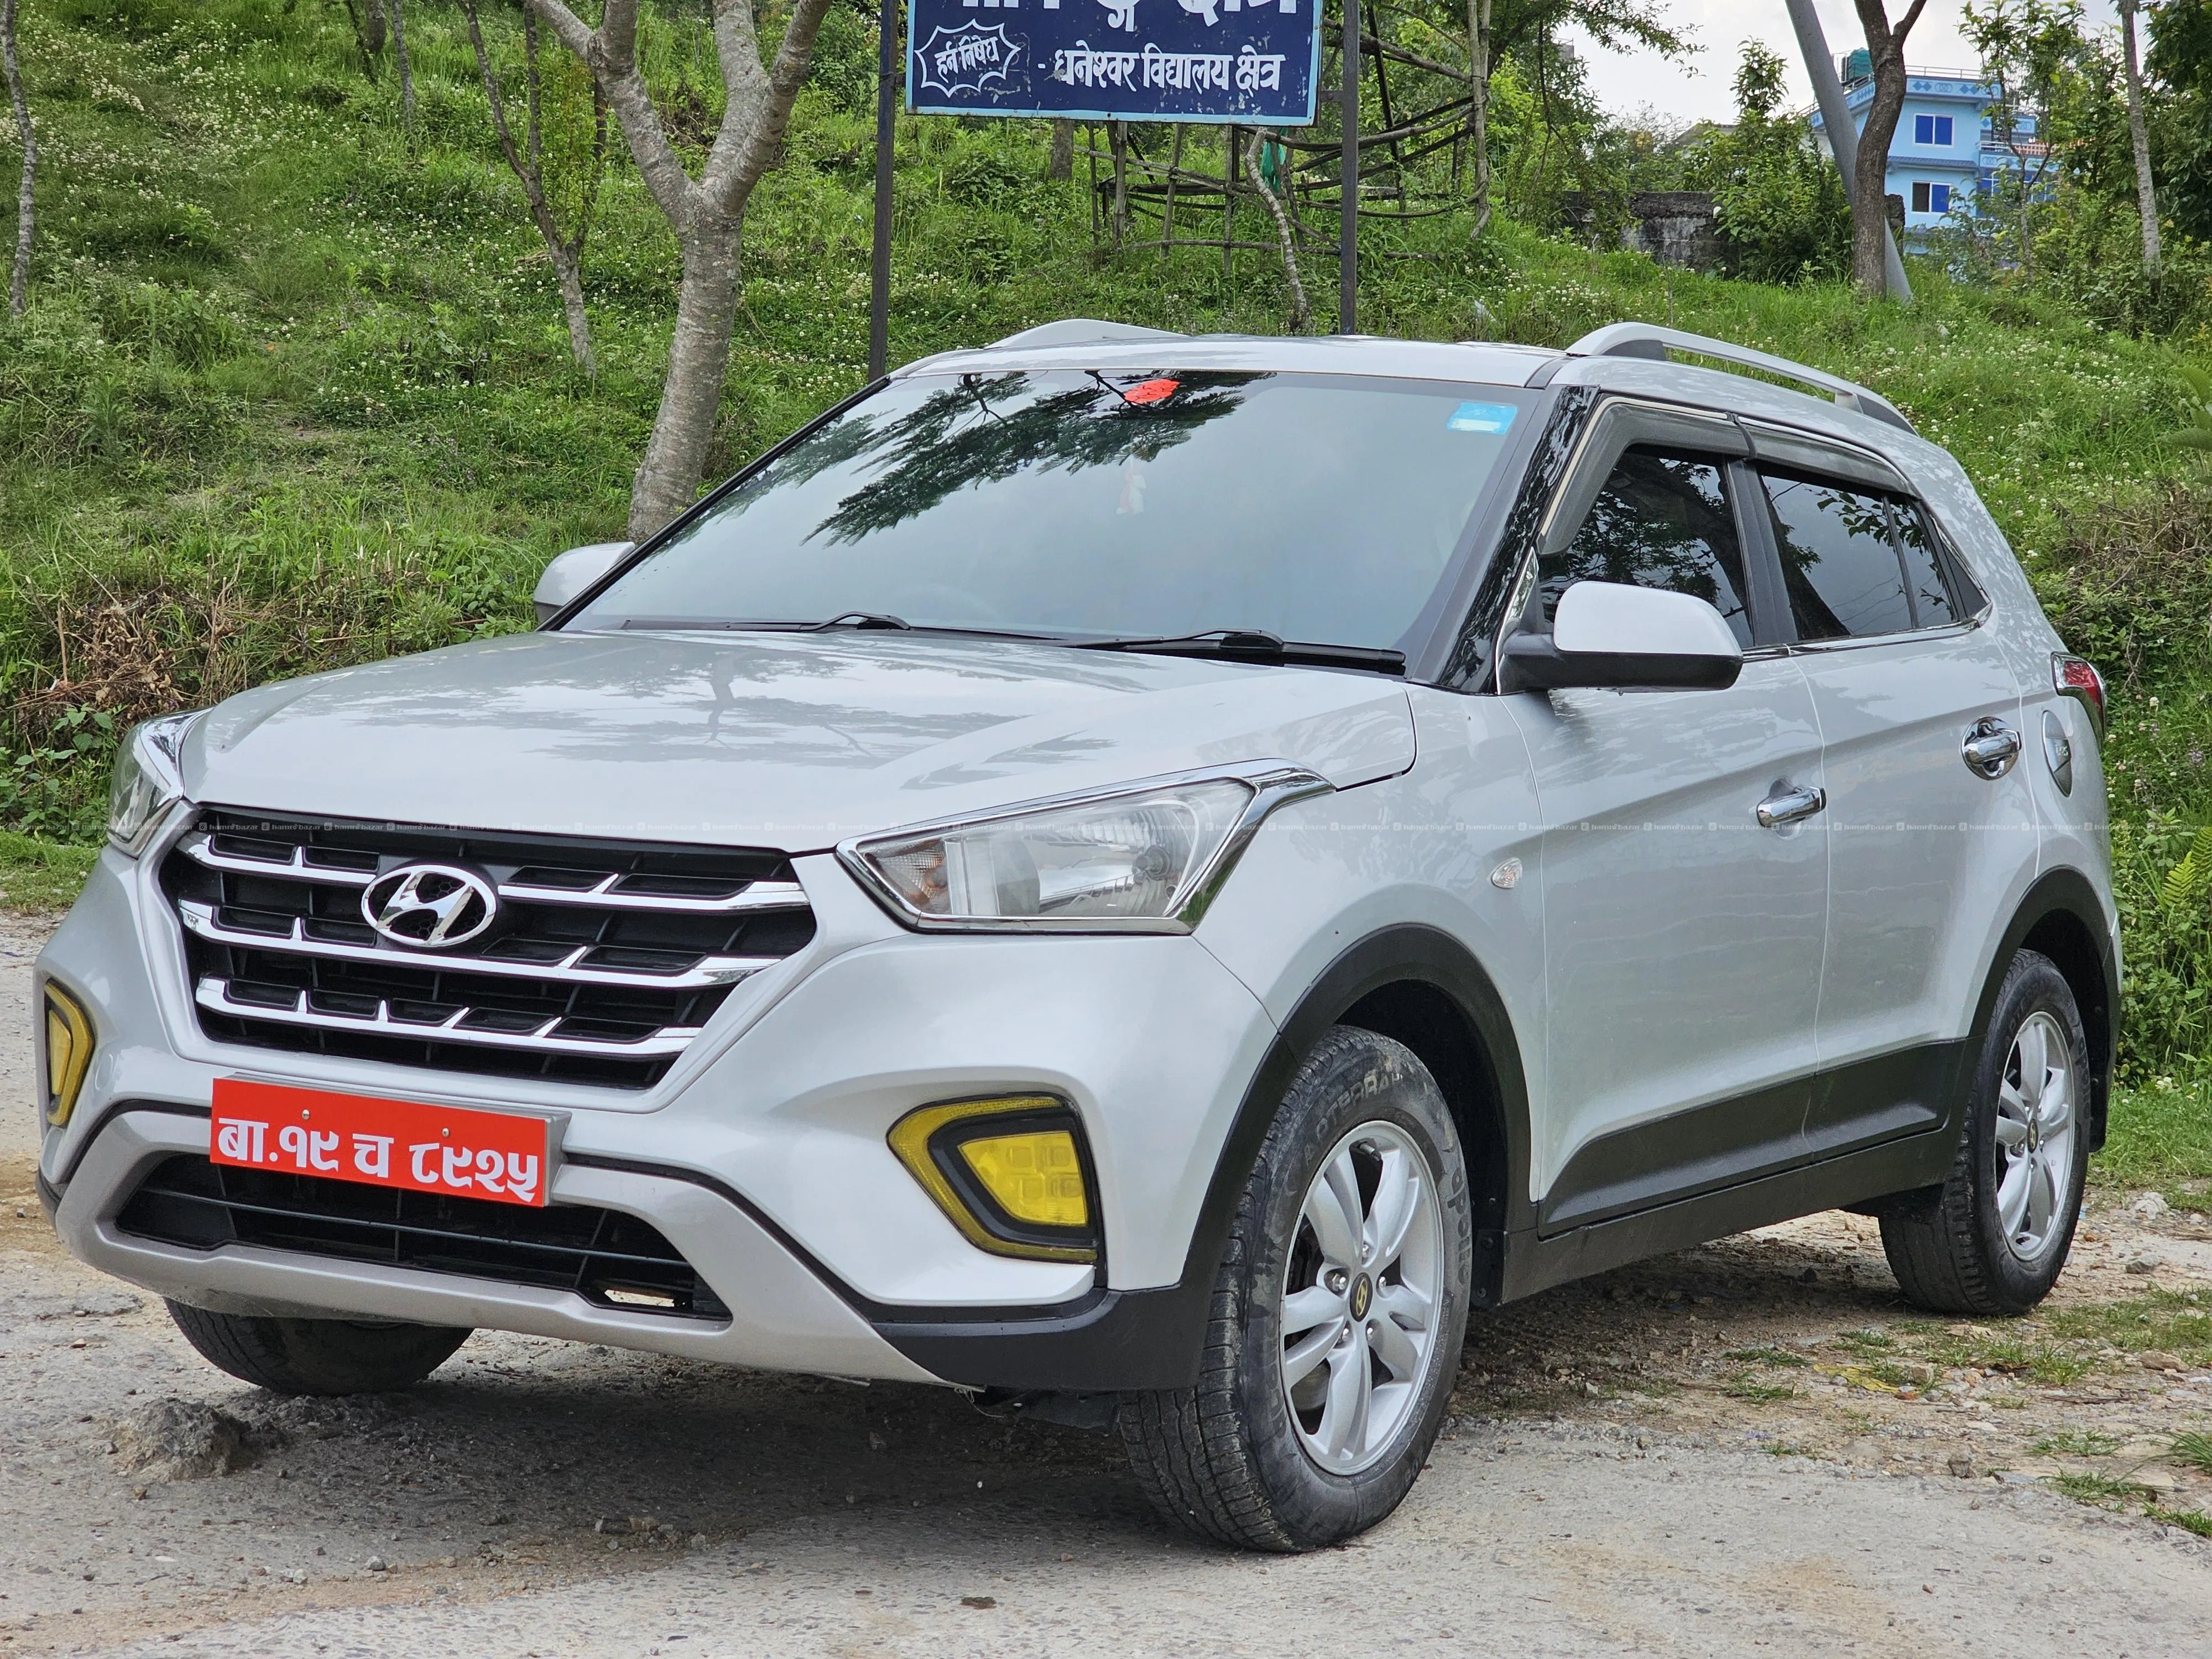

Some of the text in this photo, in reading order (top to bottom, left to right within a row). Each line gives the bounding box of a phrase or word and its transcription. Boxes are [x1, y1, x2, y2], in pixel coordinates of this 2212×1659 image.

[1055, 40, 1140, 92] धनेश्वर
[1141, 43, 1234, 95] विद्यालय
[1235, 44, 1286, 97] क्षेत्र
[353, 1133, 394, 1178] च
[409, 1142, 538, 1202] ८९२५
